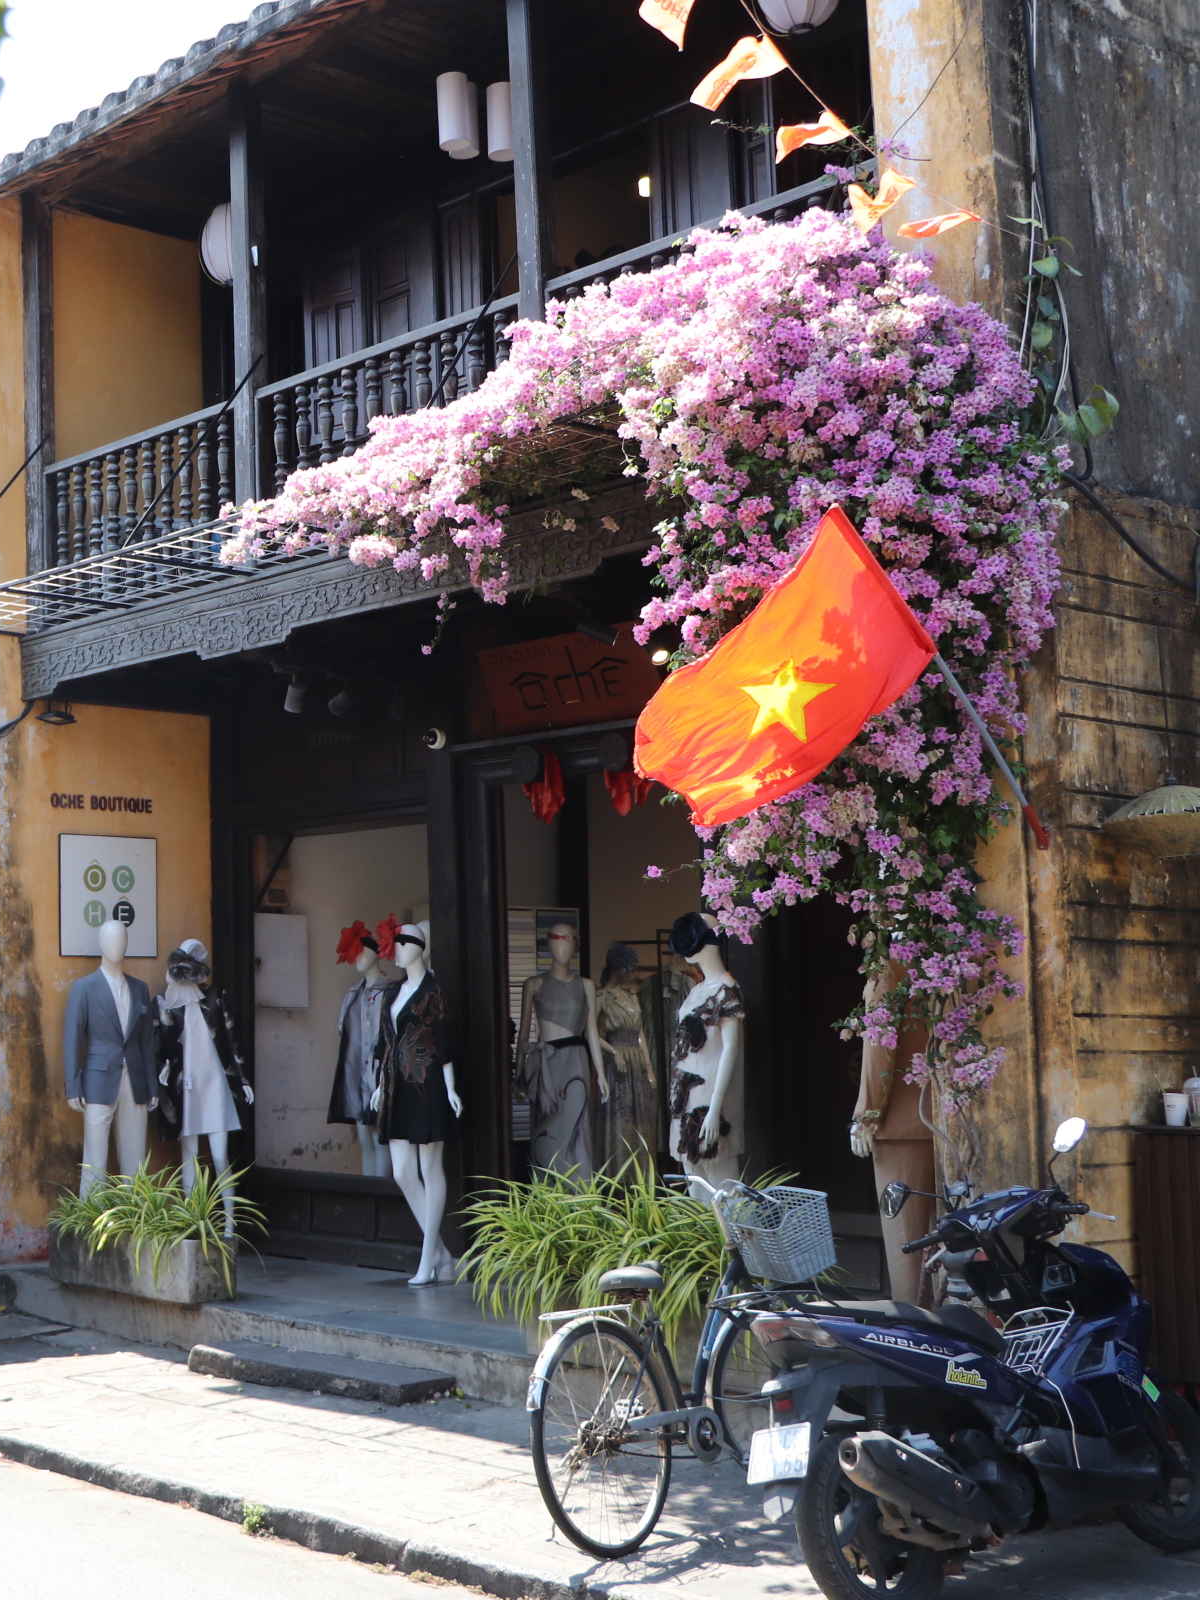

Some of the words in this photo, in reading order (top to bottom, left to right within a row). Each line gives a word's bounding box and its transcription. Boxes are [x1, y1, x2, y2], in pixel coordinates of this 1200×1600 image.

[50, 793, 84, 809] OCHE
[90, 795, 153, 814] BOUTIQUE
[865, 1332, 955, 1356] AIRBLADE
